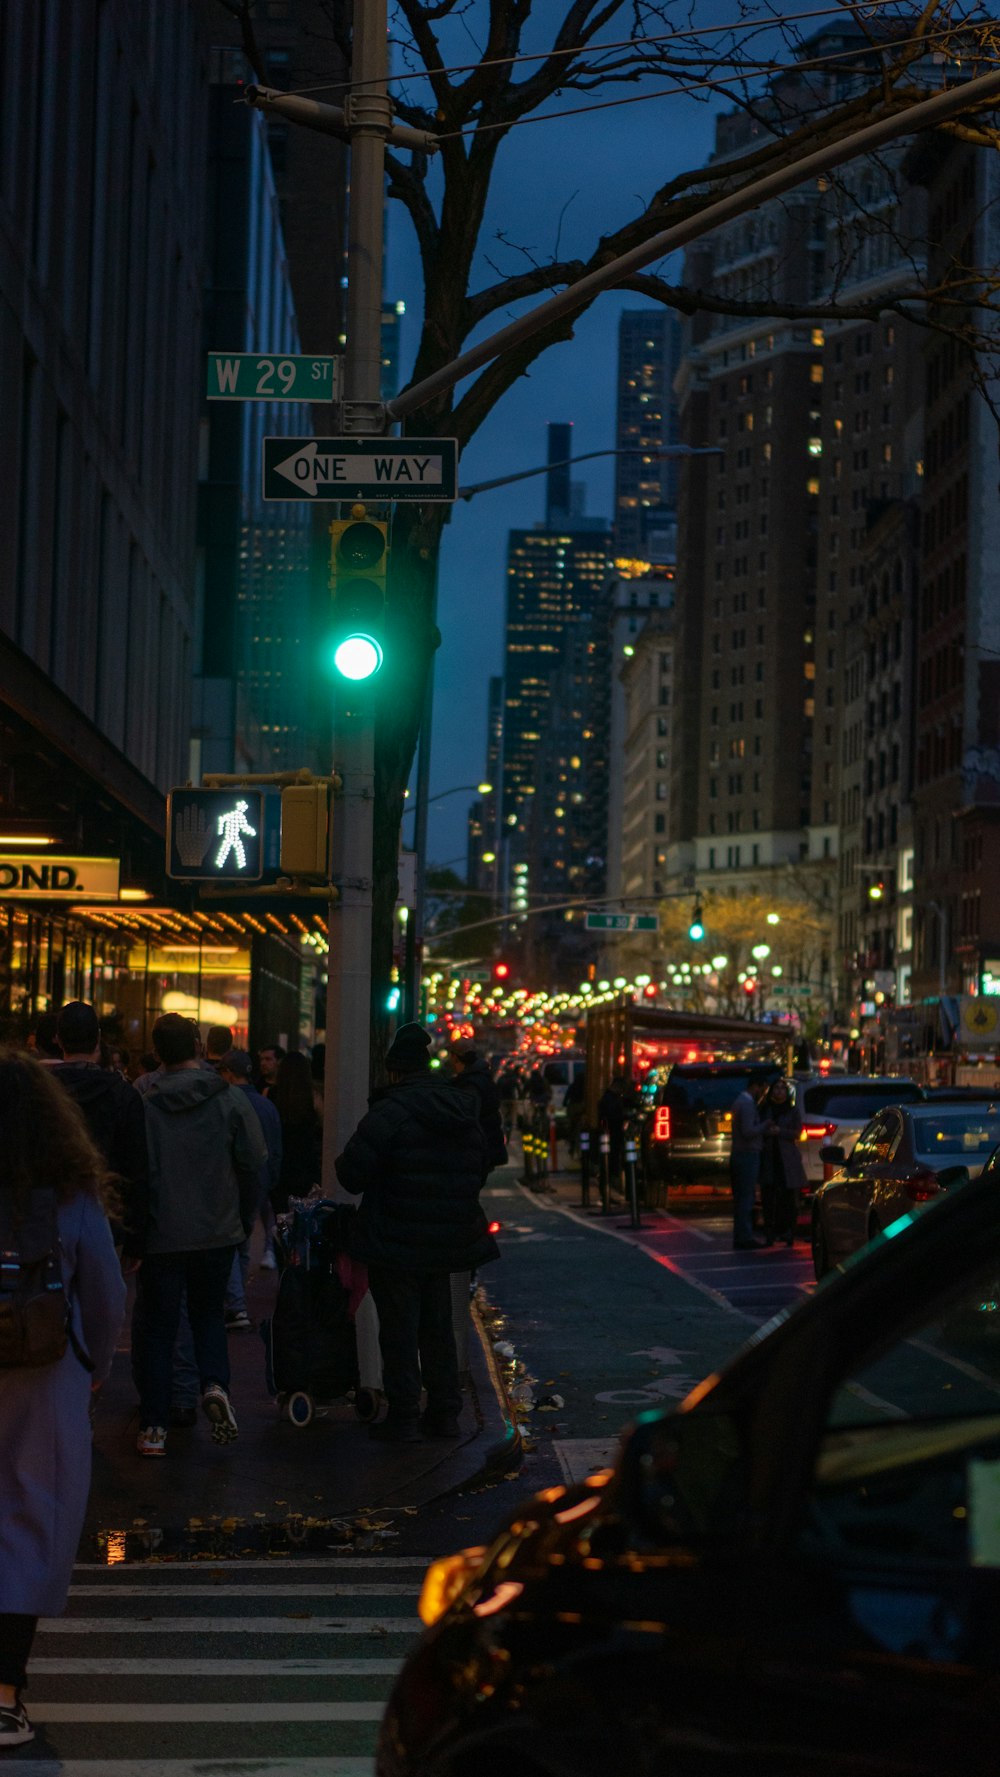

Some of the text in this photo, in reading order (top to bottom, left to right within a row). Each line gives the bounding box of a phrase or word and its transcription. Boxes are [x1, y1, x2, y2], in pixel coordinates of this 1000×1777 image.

[215, 359, 330, 394] W 29 ST
[294, 458, 431, 481] ONE WAY
